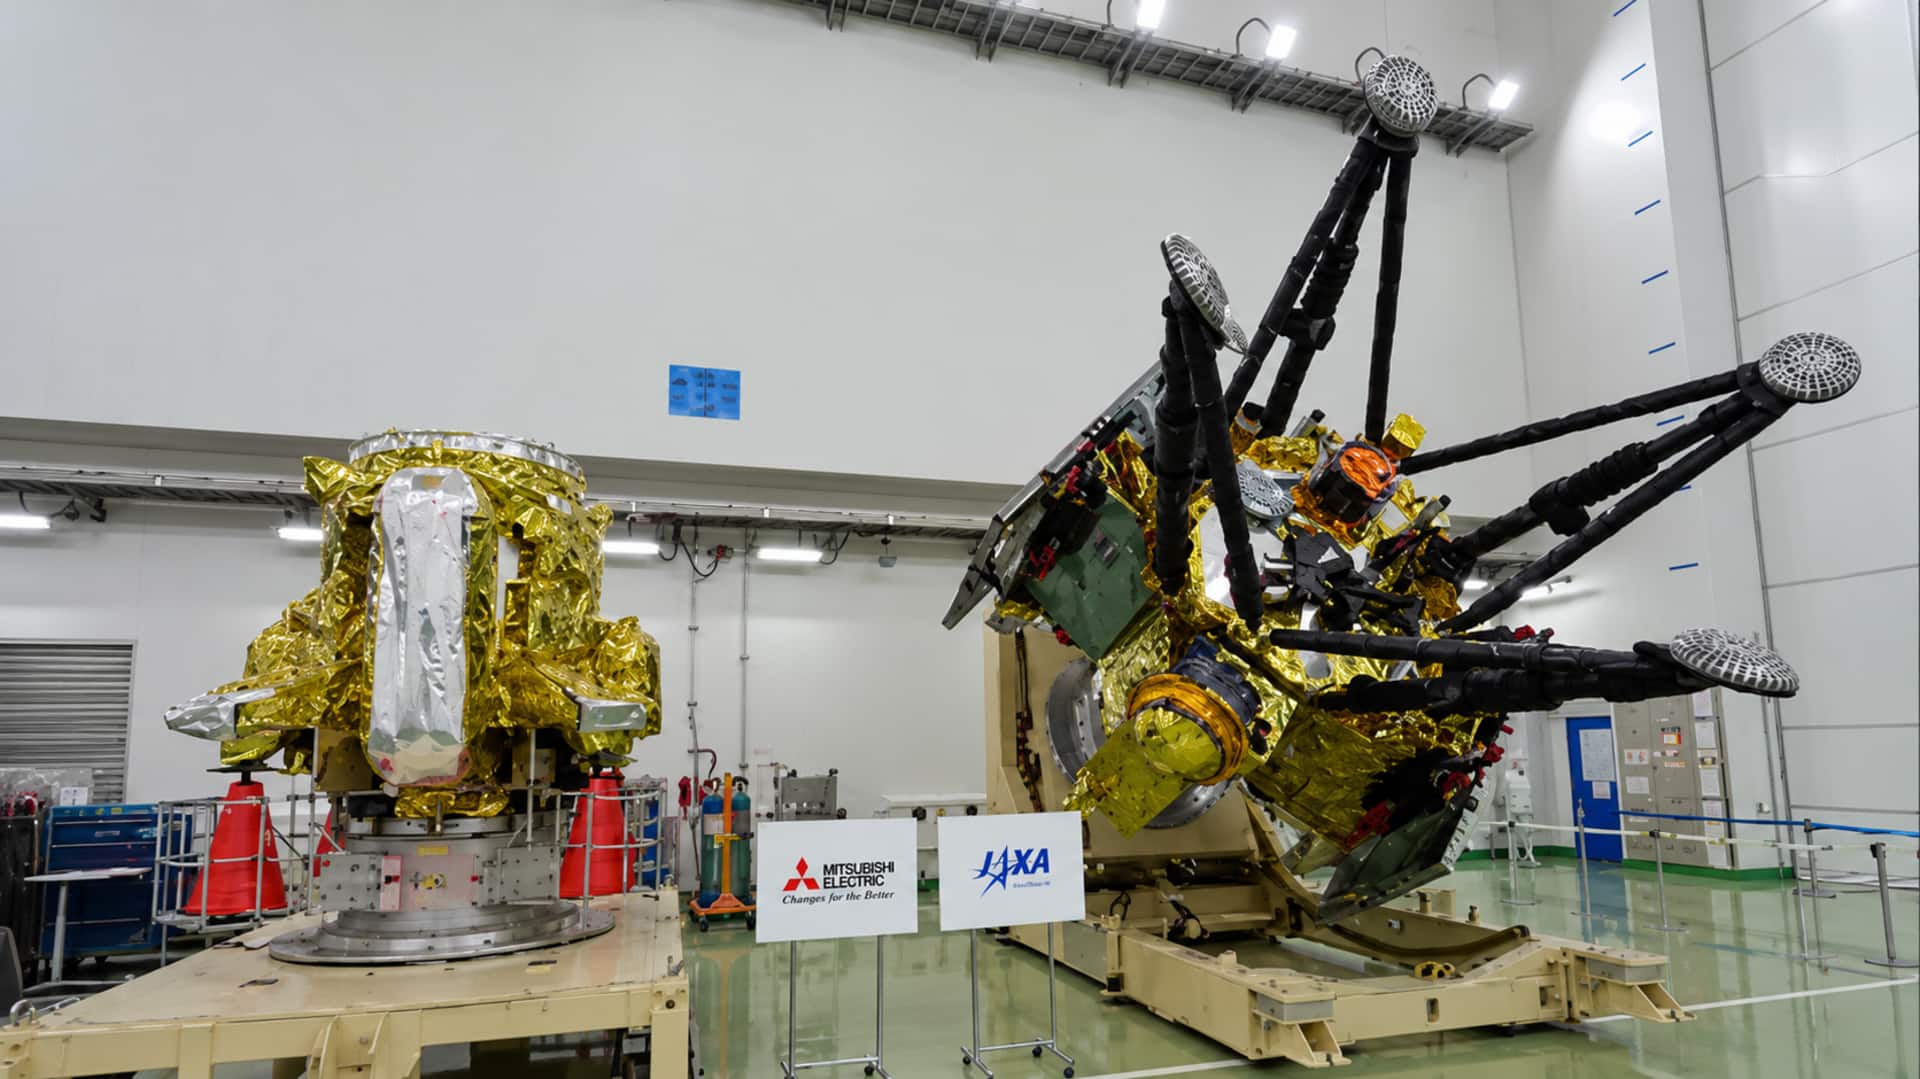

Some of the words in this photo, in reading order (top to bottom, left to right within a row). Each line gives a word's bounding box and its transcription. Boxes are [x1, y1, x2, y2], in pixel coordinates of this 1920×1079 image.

[823, 861, 895, 876] MITSUBISHI
[972, 845, 1050, 896] JAXA
[823, 875, 885, 889] ELECTRIC
[782, 894, 826, 905] Changes
[828, 893, 843, 904] for
[846, 891, 861, 901] the
[864, 890, 895, 900] Better
